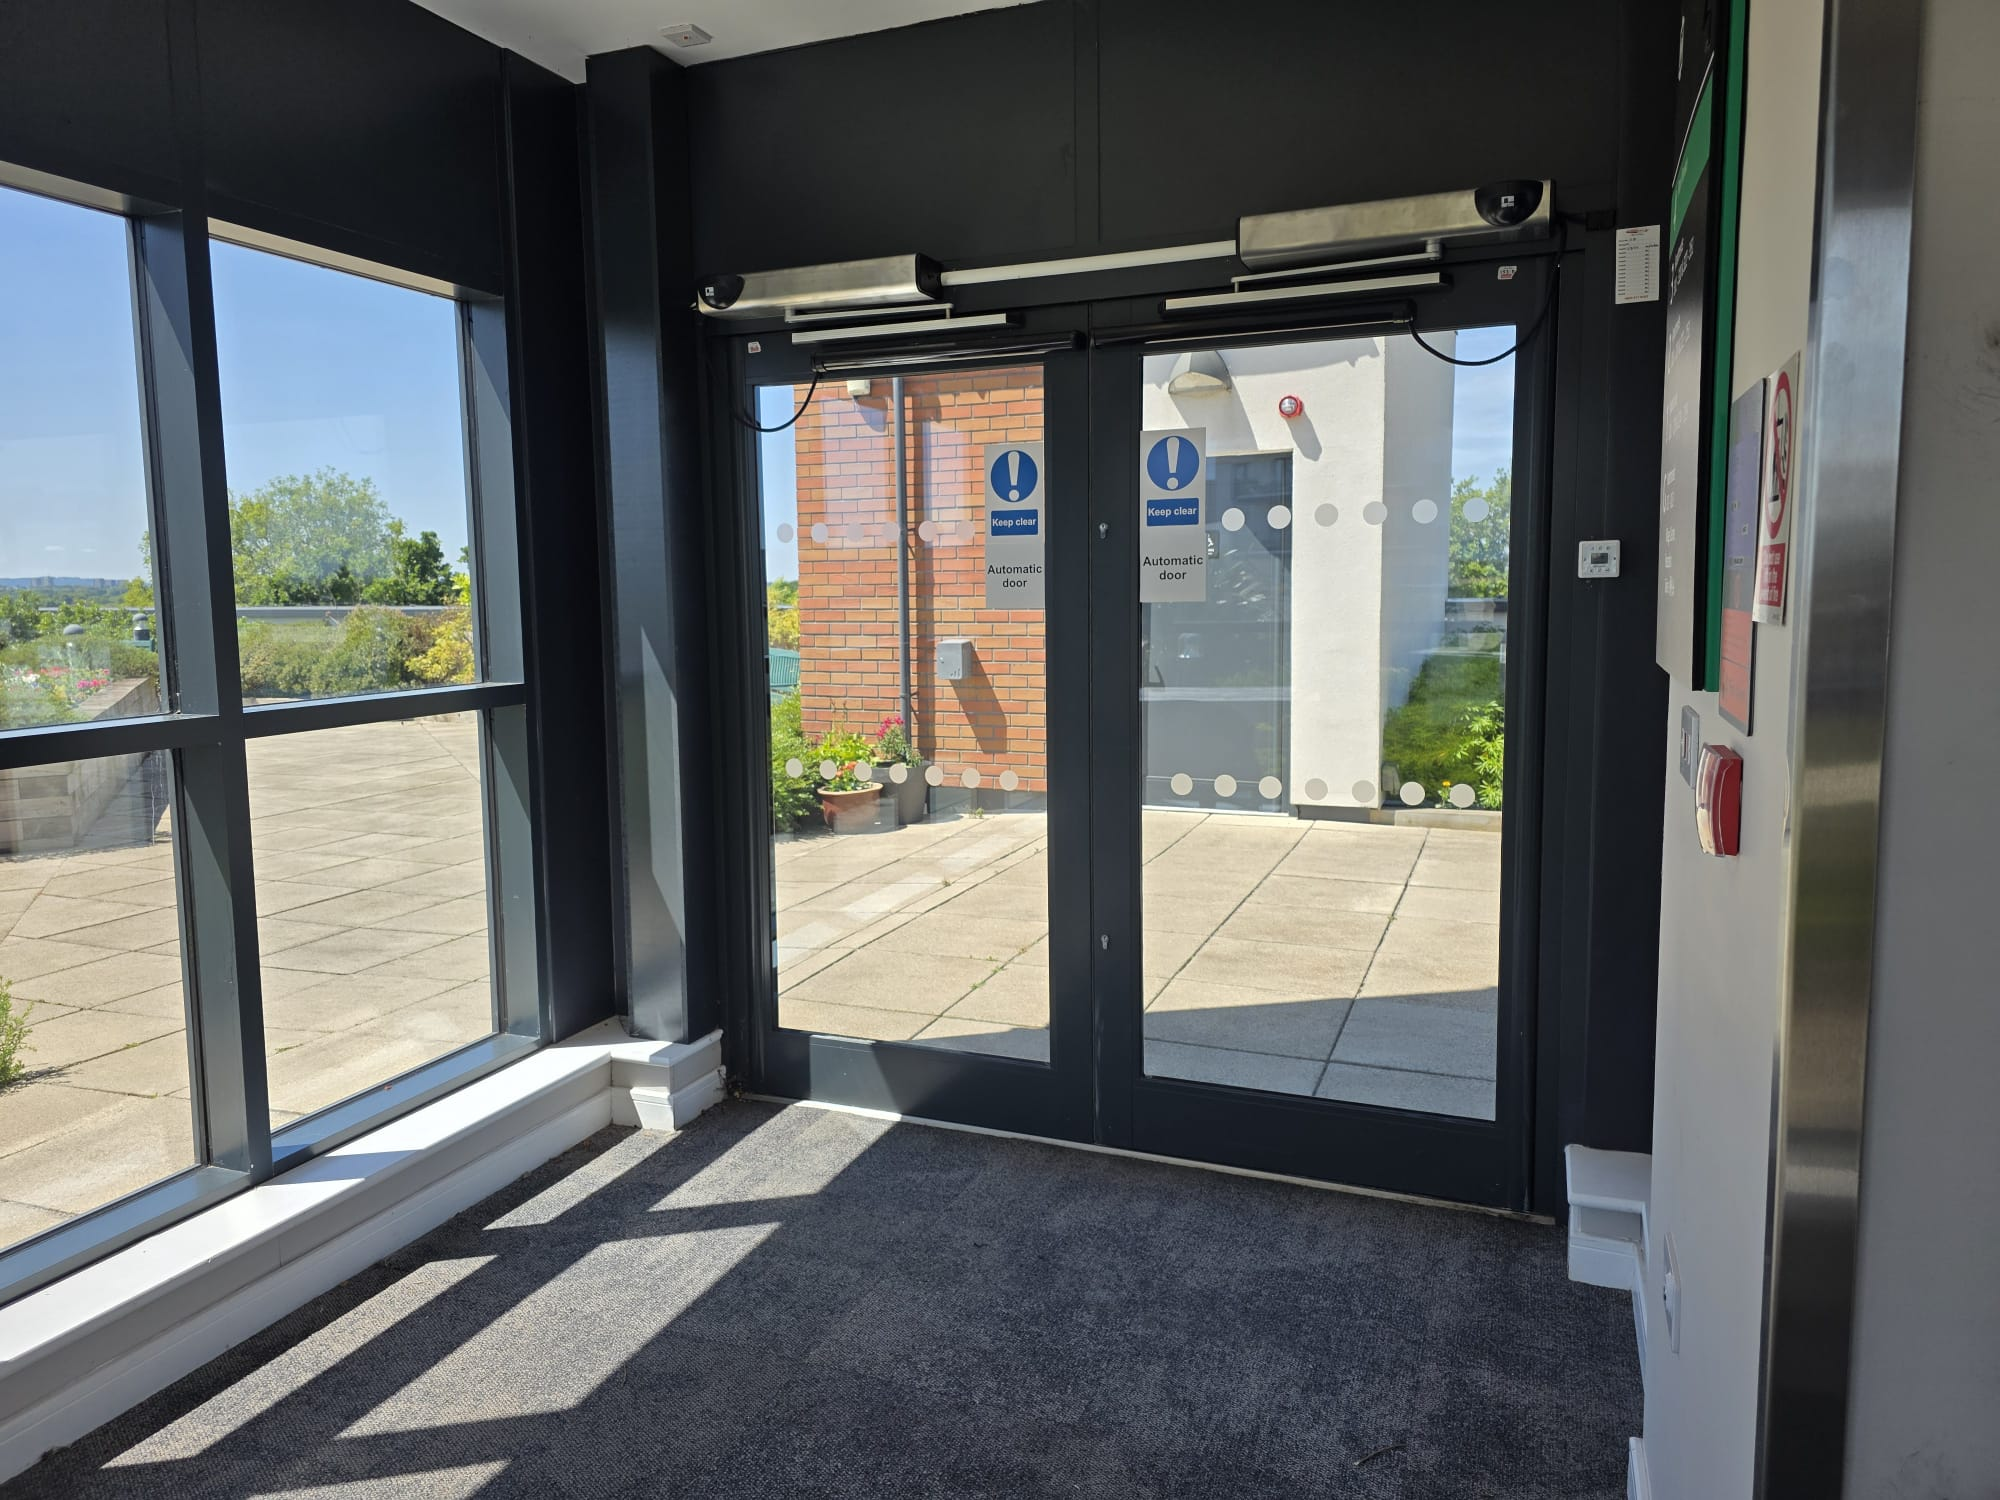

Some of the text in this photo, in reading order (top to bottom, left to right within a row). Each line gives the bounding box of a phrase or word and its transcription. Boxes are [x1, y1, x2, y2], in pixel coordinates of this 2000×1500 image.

[1148, 506, 1198, 518] Keep clear
[992, 517, 1037, 528] Keep clear
[1143, 554, 1203, 567] Automatic
[987, 563, 1043, 576] Automatic
[1159, 570, 1187, 581] door
[1002, 577, 1028, 588] door
